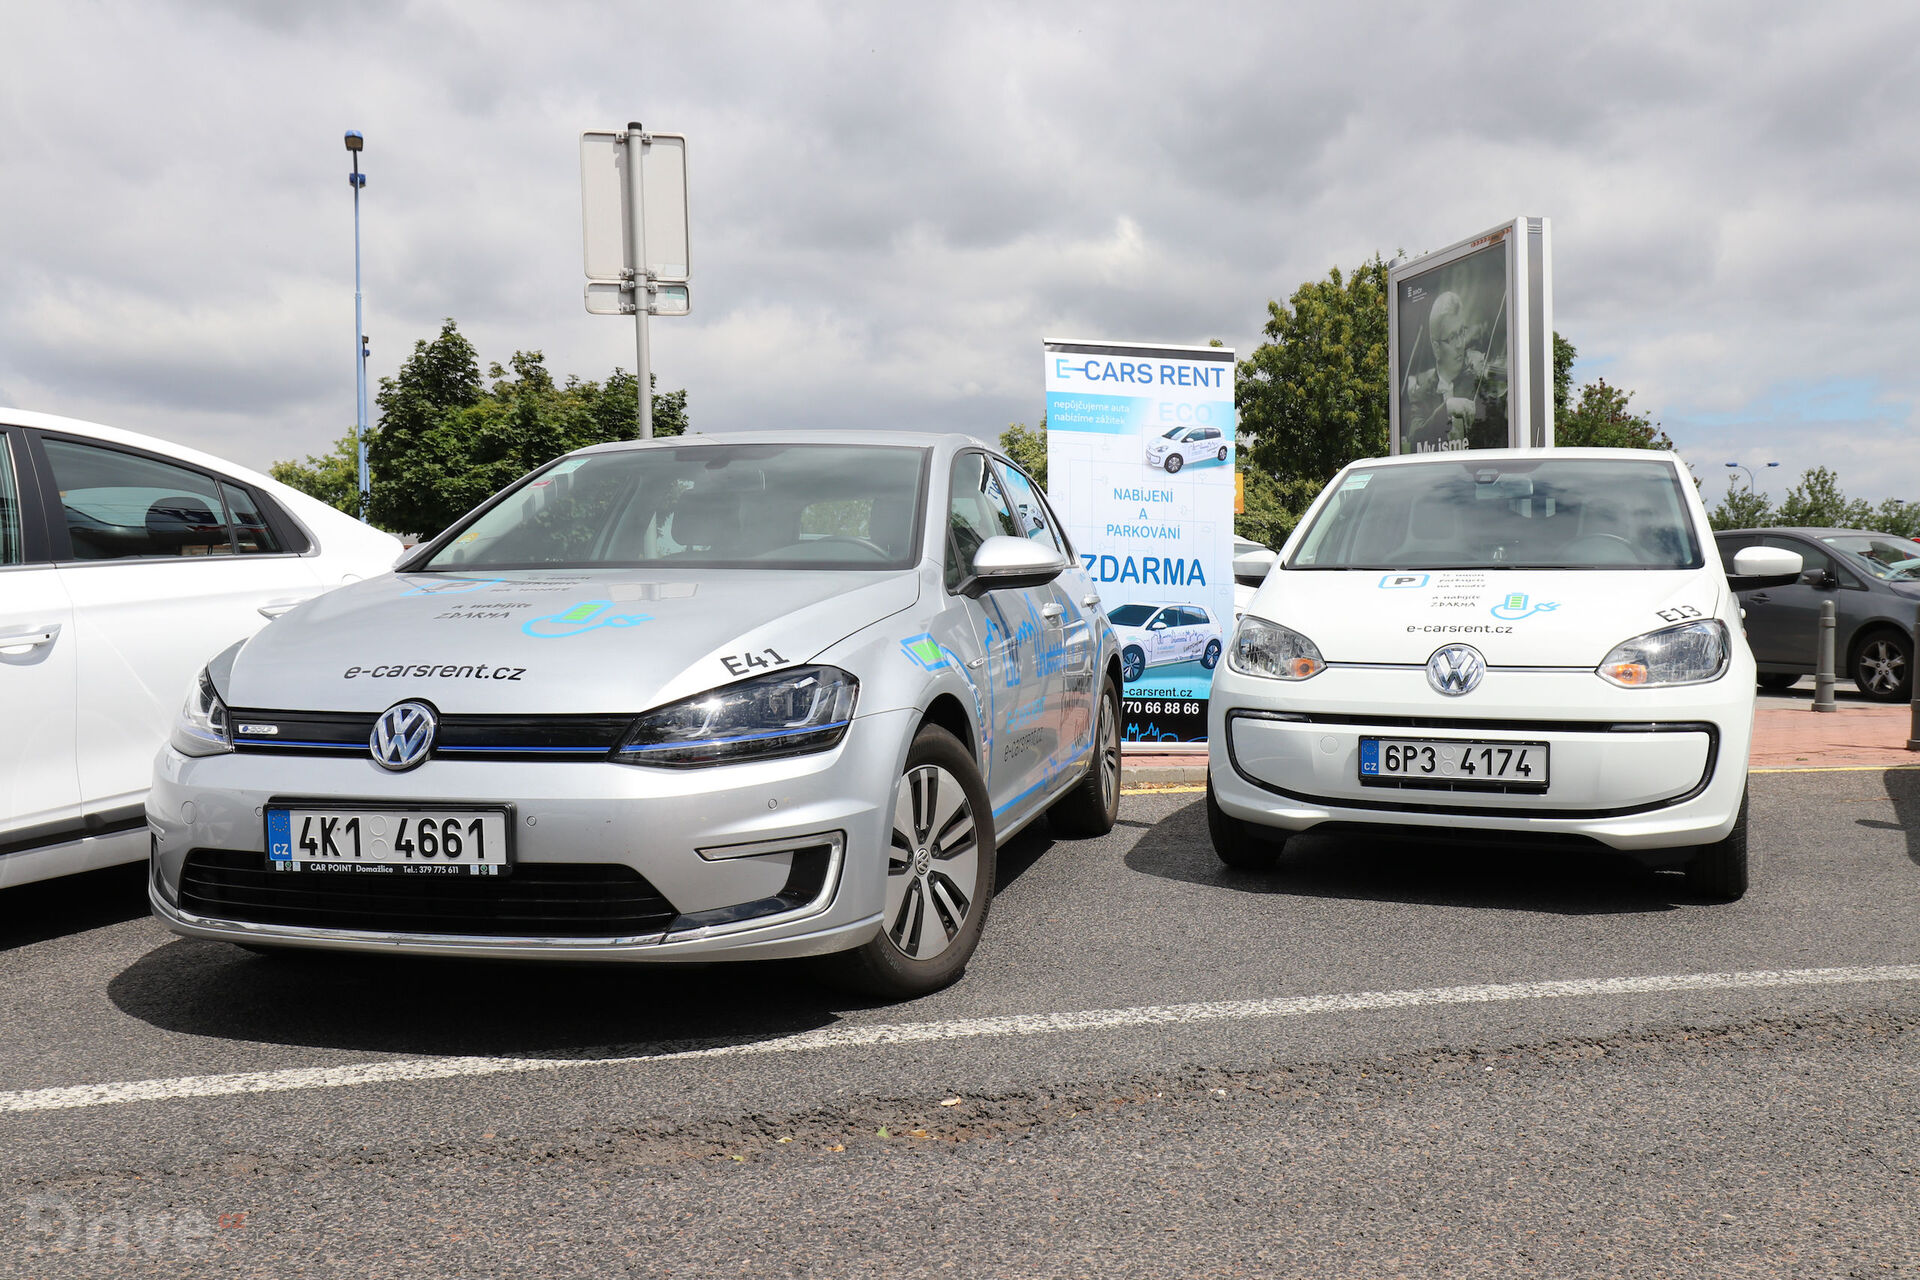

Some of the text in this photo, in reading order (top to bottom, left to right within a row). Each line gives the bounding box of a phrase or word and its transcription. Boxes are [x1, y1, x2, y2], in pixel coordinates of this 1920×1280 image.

[1160, 364, 1225, 388] RENT
[1111, 404, 1130, 413] auto
[1158, 402, 1213, 423] ECO
[1113, 486, 1173, 503] NABÍJENÍ
[1139, 507, 1148, 520] A
[1106, 523, 1181, 540] PARKOVÁNÍ
[1079, 554, 1206, 587] ZDARMA
[433, 611, 511, 620] ZDARMA
[1656, 605, 1703, 622] E13
[1406, 624, 1513, 634] e-carsrent.cz
[720, 648, 790, 677] E41
[343, 663, 527, 681] e-carsrent.cz
[1122, 687, 1193, 698] -carsrent.cz
[1145, 701, 1161, 714] 66
[1164, 702, 1180, 714] 88
[1183, 702, 1200, 715] 66
[1364, 762, 1377, 771] CZ
[1385, 745, 1531, 777] 6P3 4174
[299, 816, 485, 859] 4K1 4661
[273, 843, 289, 855] CZ
[310, 863, 459, 874] CAR POINT Domažlice Tel.: 379 775 611
